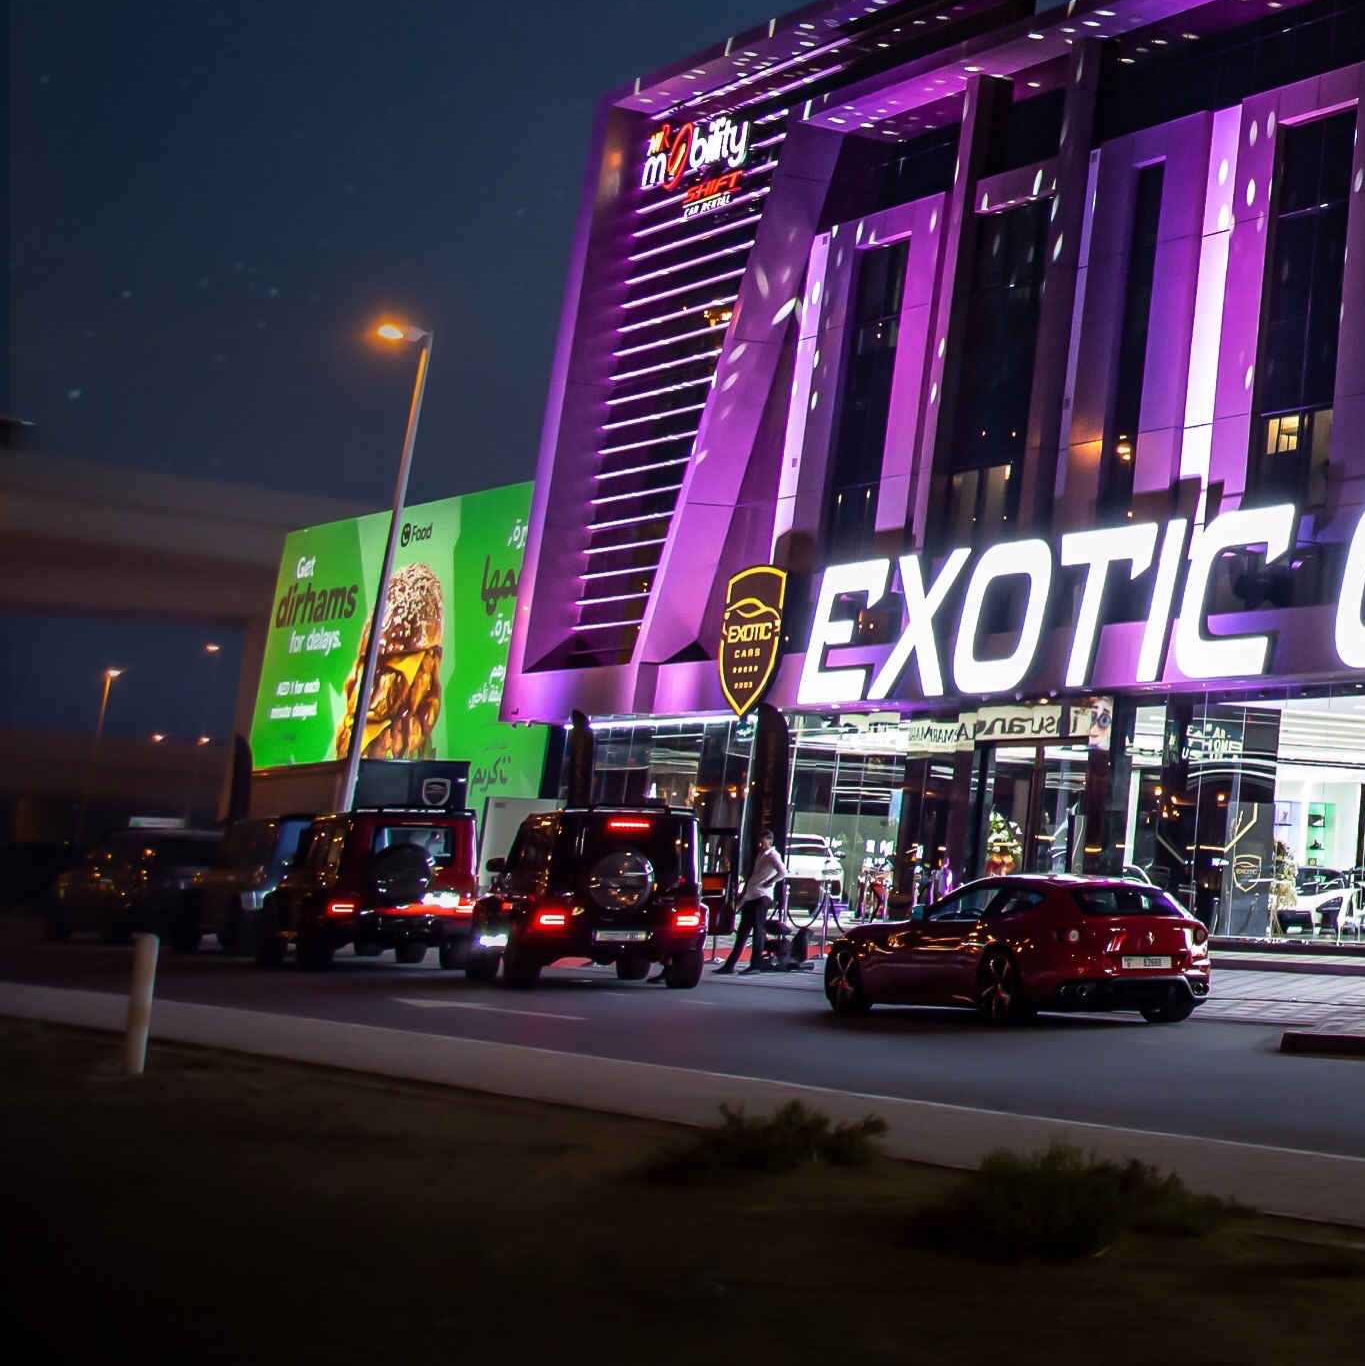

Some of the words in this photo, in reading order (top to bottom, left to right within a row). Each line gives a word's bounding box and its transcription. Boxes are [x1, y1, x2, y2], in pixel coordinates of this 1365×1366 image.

[682, 170, 744, 204] SHIFT
[411, 521, 433, 542] Food
[296, 556, 316, 579] Get
[275, 582, 359, 628] dirhams
[797, 503, 1297, 705] EXOTIC
[289, 632, 304, 653] for
[306, 629, 342, 656] delays.
[727, 622, 772, 643] EXOTIC
[734, 648, 760, 658] CARS
